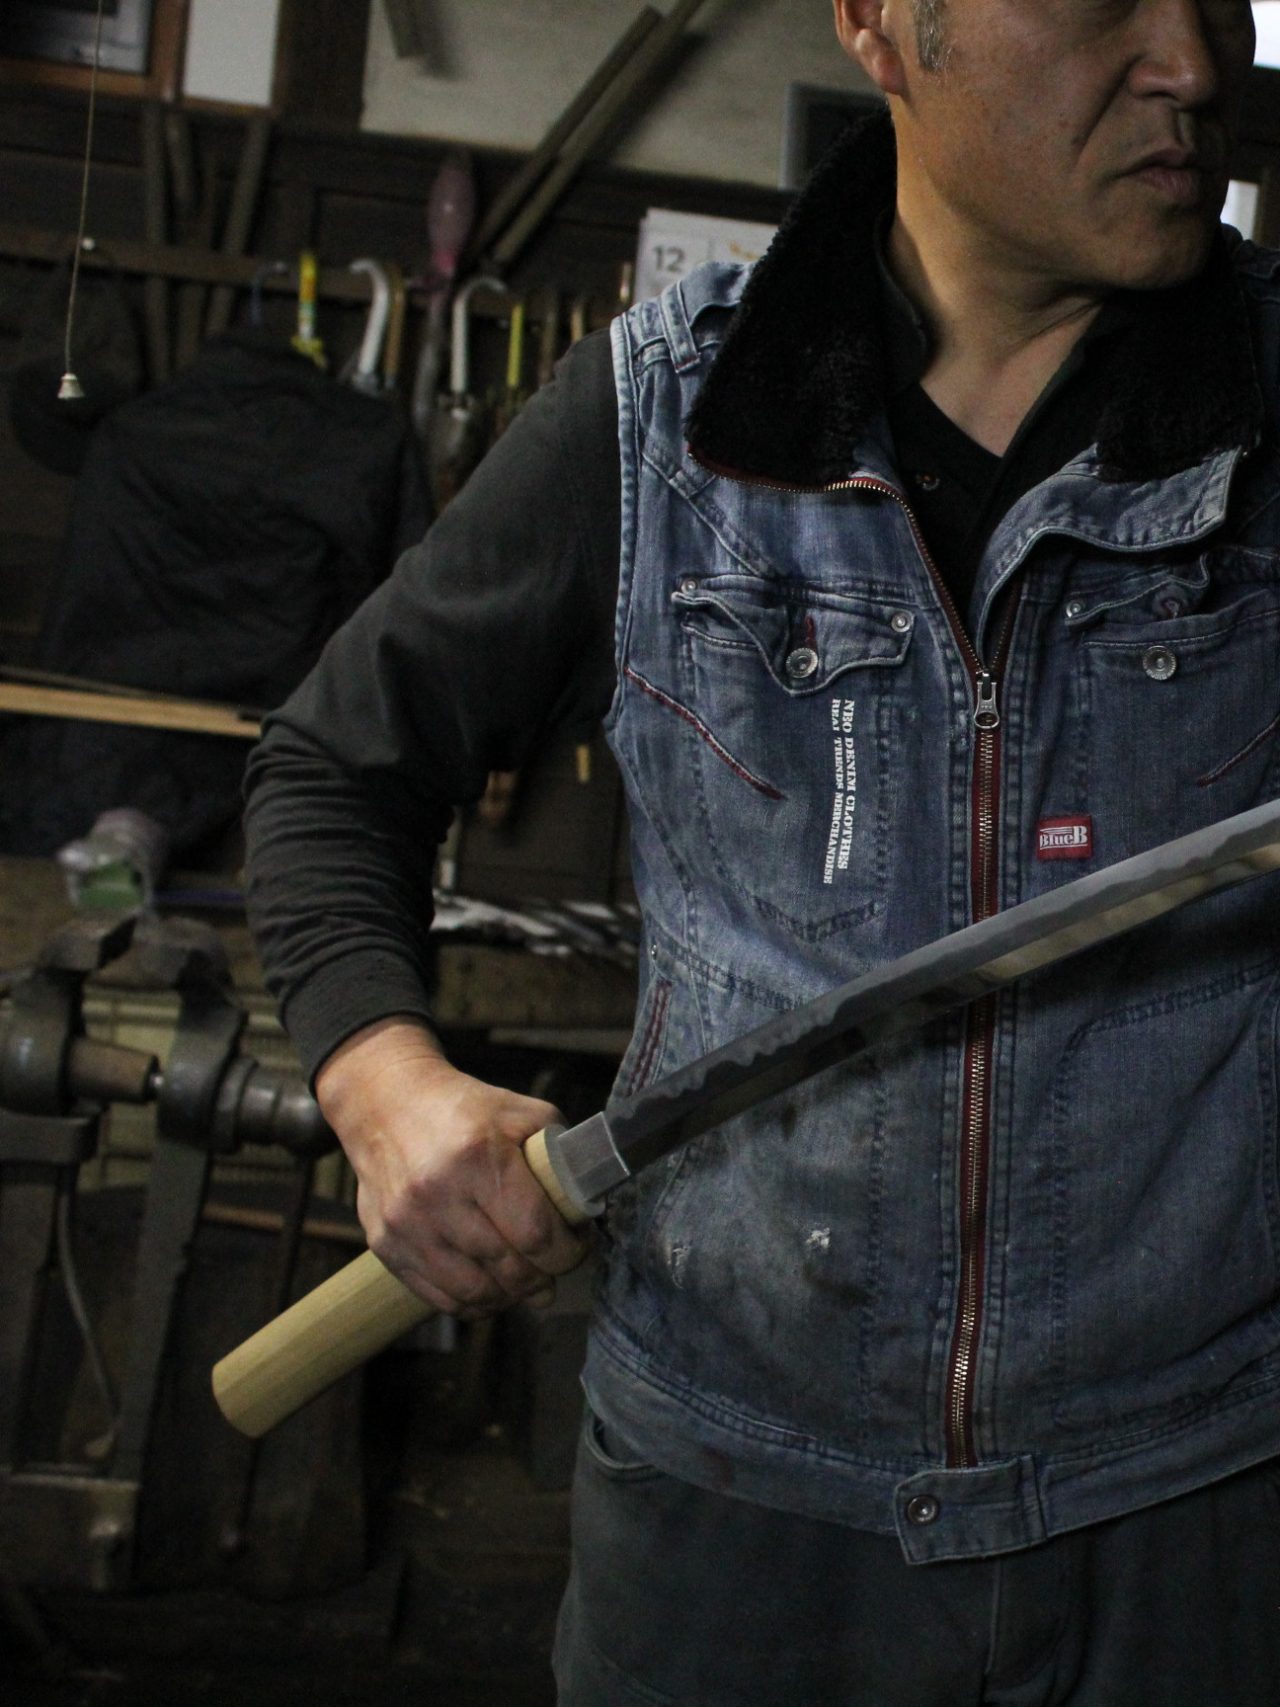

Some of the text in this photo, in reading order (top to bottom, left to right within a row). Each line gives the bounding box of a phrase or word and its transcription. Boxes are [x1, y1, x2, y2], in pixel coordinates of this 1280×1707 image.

[654, 245, 685, 273] 12
[834, 737, 844, 790] TRENDS
[837, 699, 856, 870] NEO DENIM CLOTHES
[823, 792, 844, 885] MERCHANDISE
